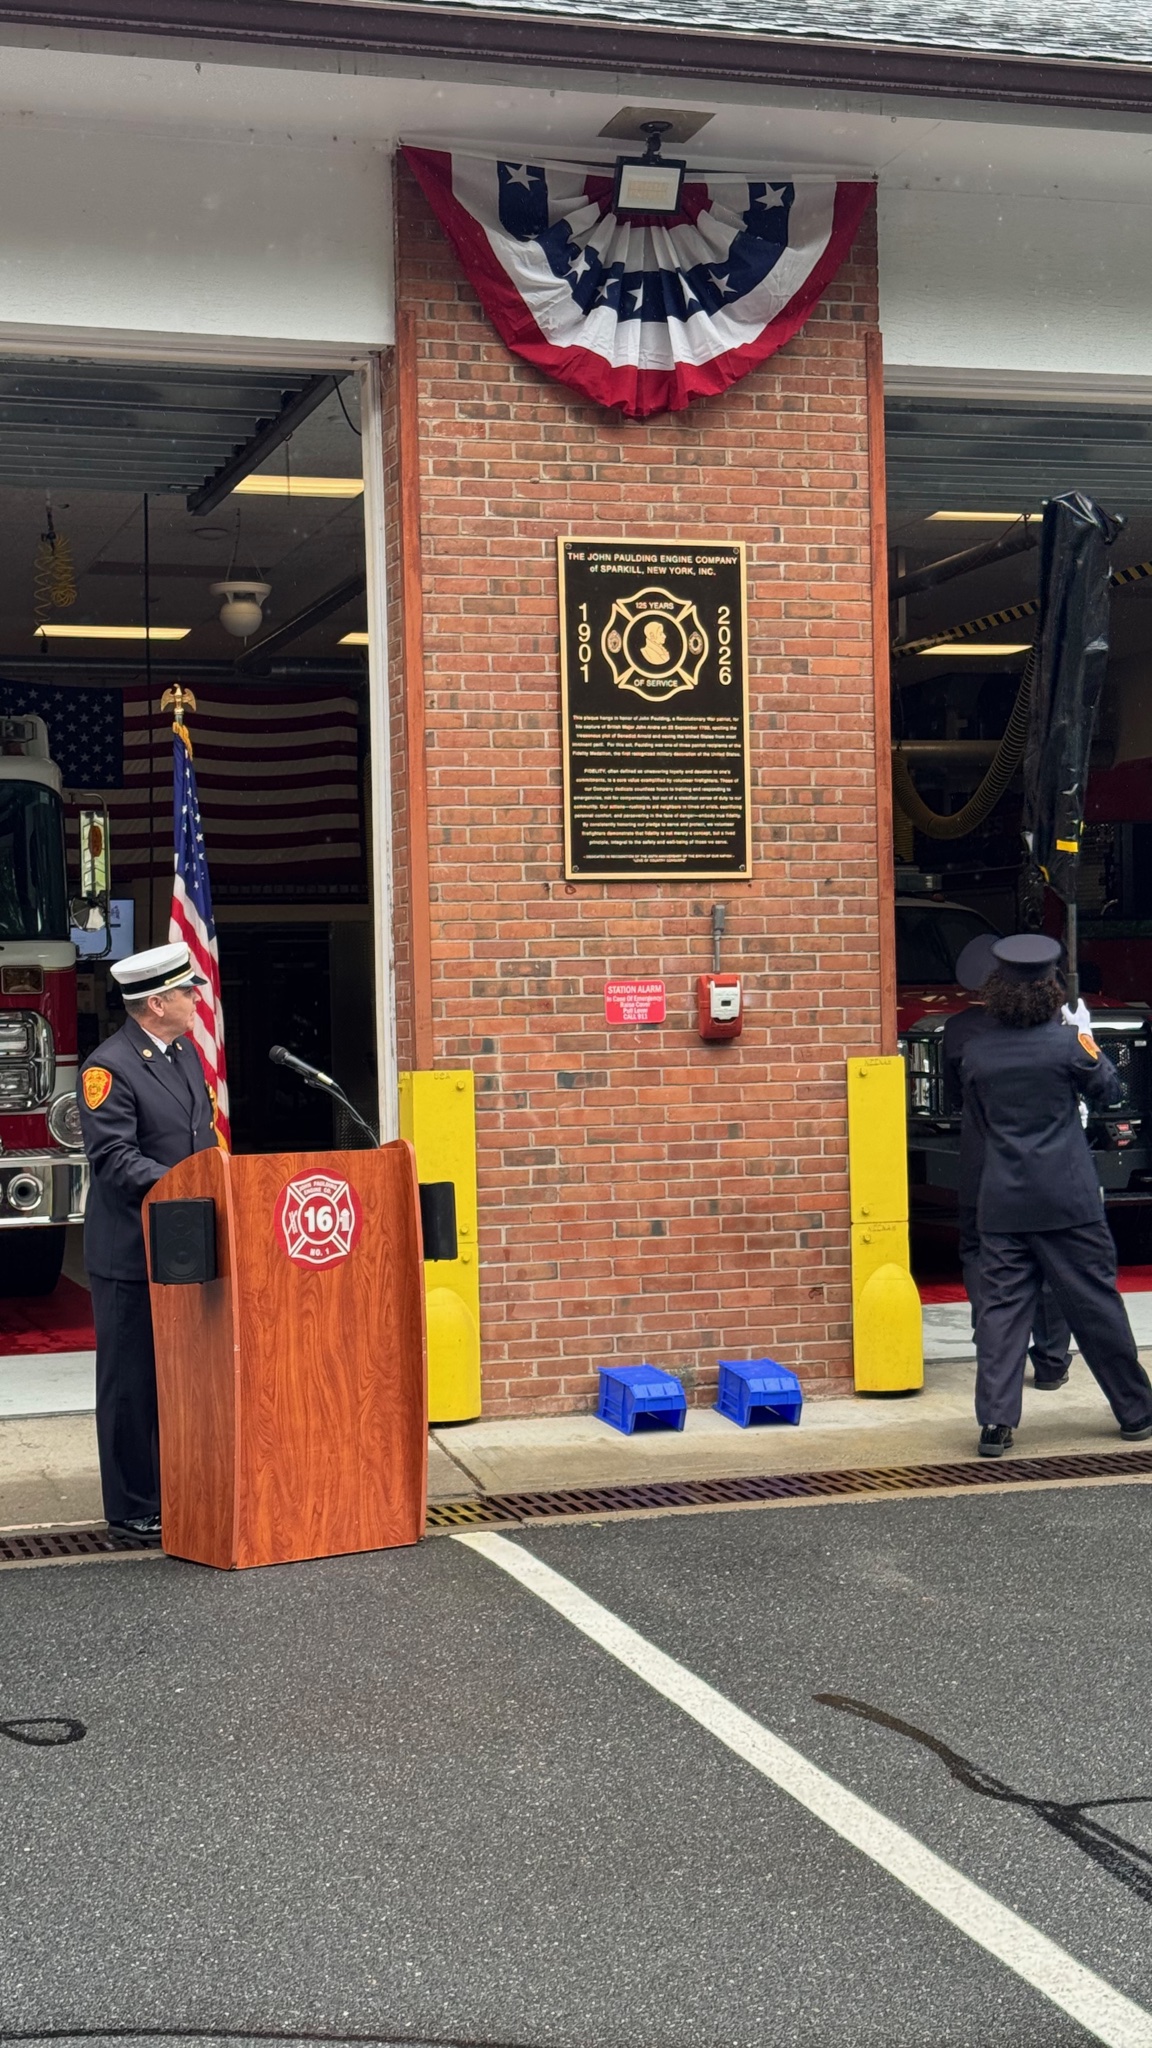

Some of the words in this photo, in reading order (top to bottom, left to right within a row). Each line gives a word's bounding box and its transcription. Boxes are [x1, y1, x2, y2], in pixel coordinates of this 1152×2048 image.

[567, 552, 585, 560] THE
[587, 553, 612, 561] JOHN
[614, 554, 658, 562] PAULDING
[660, 555, 693, 564] ENGINE
[695, 556, 738, 564] COMPANY
[600, 565, 644, 575] SPARKILL,
[647, 566, 667, 574] NEW
[669, 567, 696, 576] YORK,
[698, 568, 717, 576] INC.
[578, 602, 592, 683] 1901
[717, 606, 732, 686] 2026
[634, 679, 645, 687] OF
[646, 679, 678, 687] SERVICE
[608, 985, 636, 994] STATION
[638, 984, 662, 993] ALARM
[313, 1180, 338, 1190] PAULDING
[304, 1206, 333, 1232] 16
[310, 1248, 323, 1257] NO.
